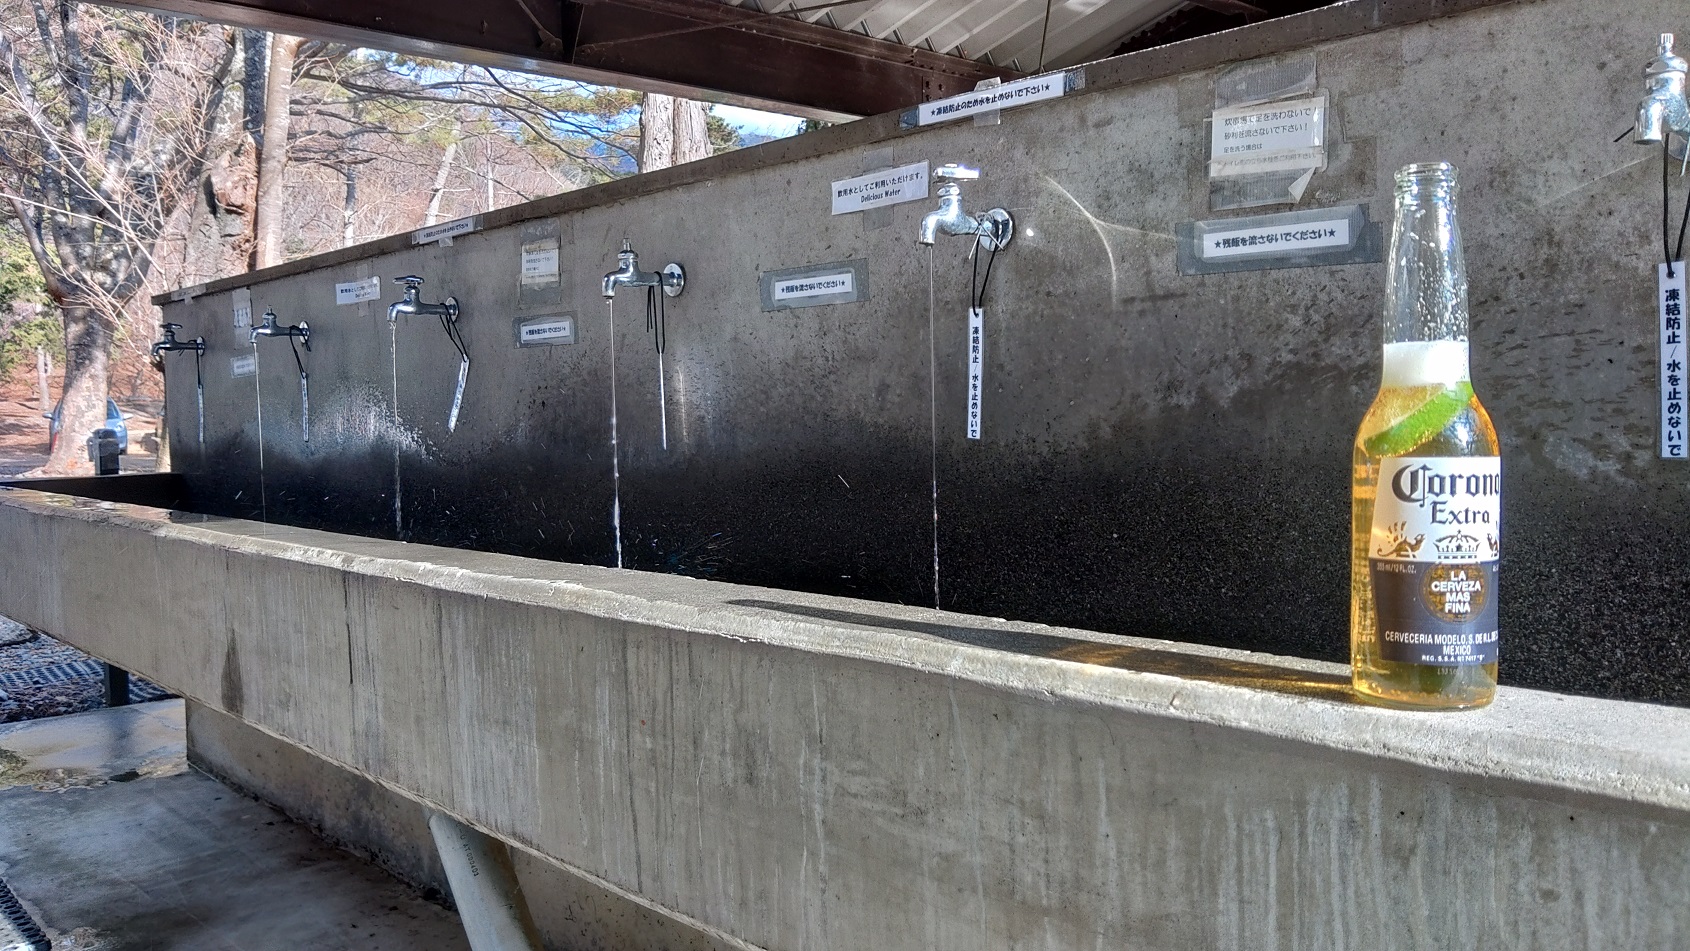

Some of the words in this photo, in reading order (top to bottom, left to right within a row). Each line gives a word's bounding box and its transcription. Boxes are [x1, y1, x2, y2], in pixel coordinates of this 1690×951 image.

[860, 192, 884, 203] Delicious
[884, 188, 901, 199] Water
[1429, 500, 1491, 526] Extra
[1450, 570, 1466, 581] LA
[1431, 580, 1482, 592] CERVEZA
[1445, 591, 1471, 603] MAS
[1444, 602, 1471, 613] FINA
[1385, 630, 1433, 645] CERVECERIA
[1442, 644, 1472, 656] MEXICO
